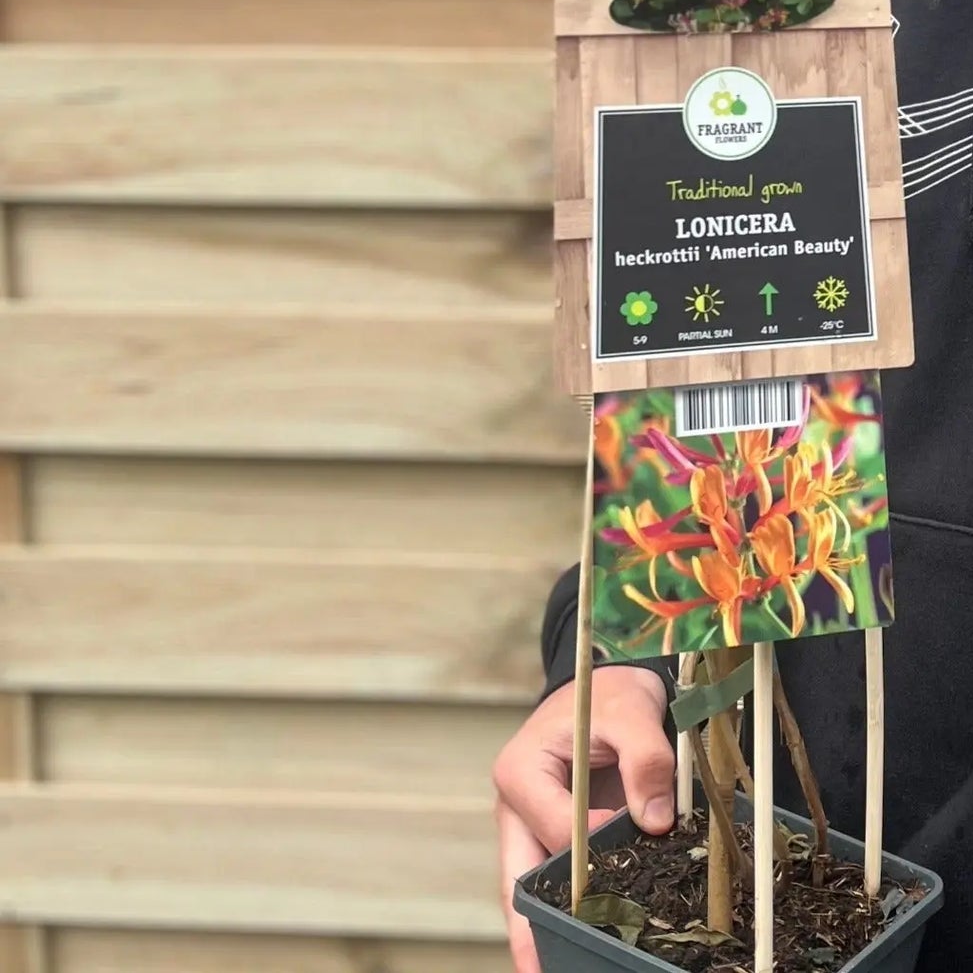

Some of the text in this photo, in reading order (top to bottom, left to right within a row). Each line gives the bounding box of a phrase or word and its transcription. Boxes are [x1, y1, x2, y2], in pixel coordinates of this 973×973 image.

[697, 122, 763, 136] FRAGRANT
[715, 136, 747, 144] FLOWERS
[666, 174, 803, 203] Traditional grown
[675, 212, 796, 239] LONICERA
[615, 236, 854, 267] heckrottii 'American Beauty'
[678, 329, 733, 341] PARTIAL SUN
